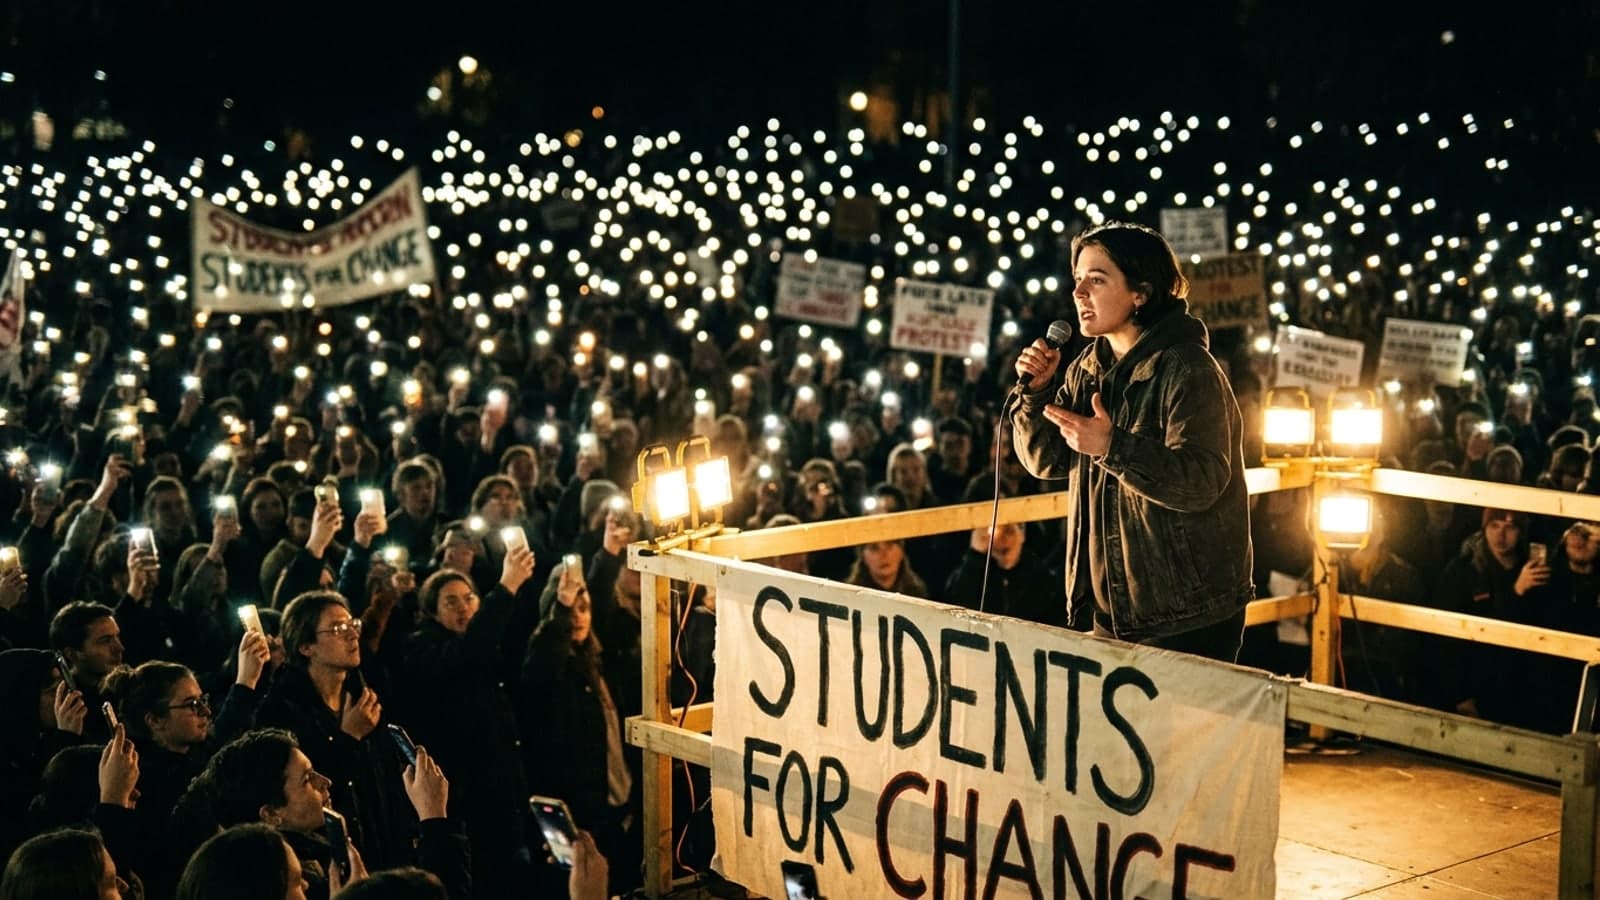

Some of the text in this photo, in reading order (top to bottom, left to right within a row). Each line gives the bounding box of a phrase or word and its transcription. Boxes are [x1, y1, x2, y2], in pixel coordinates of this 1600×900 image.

[201, 254, 311, 295] STUDENTS
[347, 230, 421, 284] CHANGE
[748, 585, 1160, 816] STUDENTS
[744, 737, 855, 873] FOR
